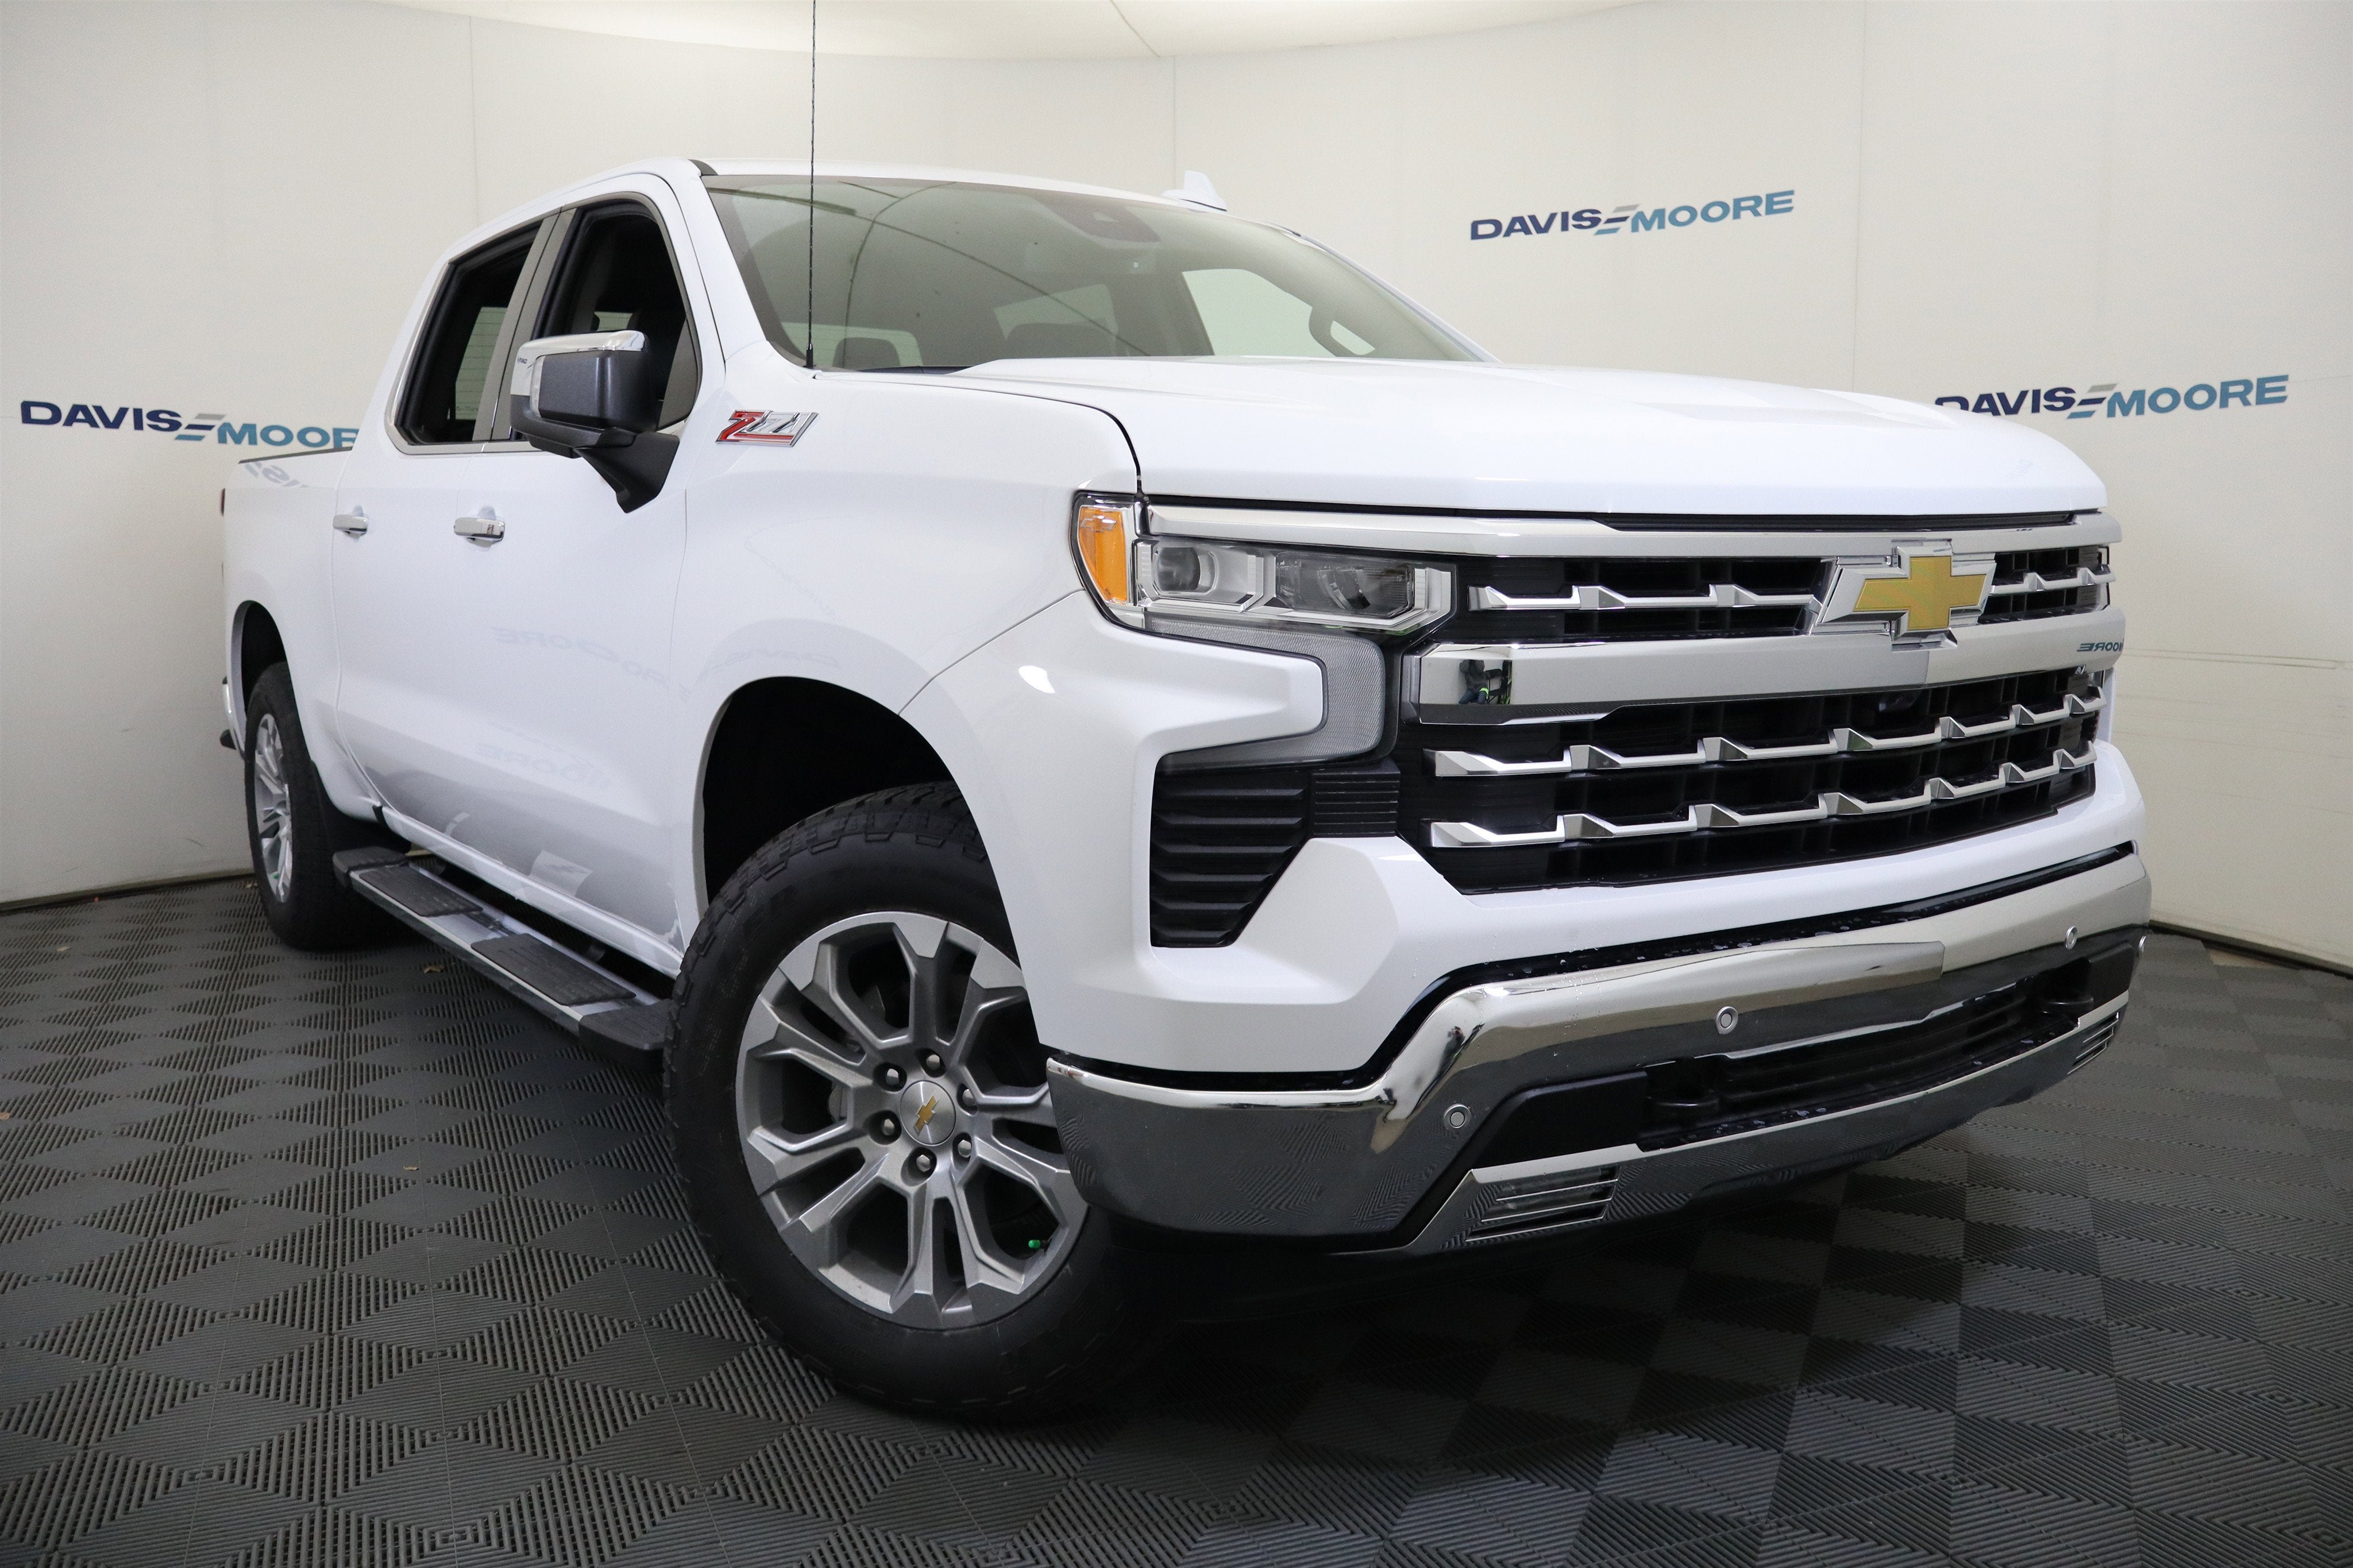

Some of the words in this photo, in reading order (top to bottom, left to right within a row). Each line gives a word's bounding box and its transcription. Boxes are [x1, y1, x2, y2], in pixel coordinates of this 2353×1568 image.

[1471, 210, 1603, 241] DAVIS
[1631, 190, 1795, 233] MOORE
[2107, 375, 2289, 418] MOORE
[21, 400, 182, 432] DAVIS
[218, 422, 360, 449] MOOR
[715, 410, 819, 447] Z71
